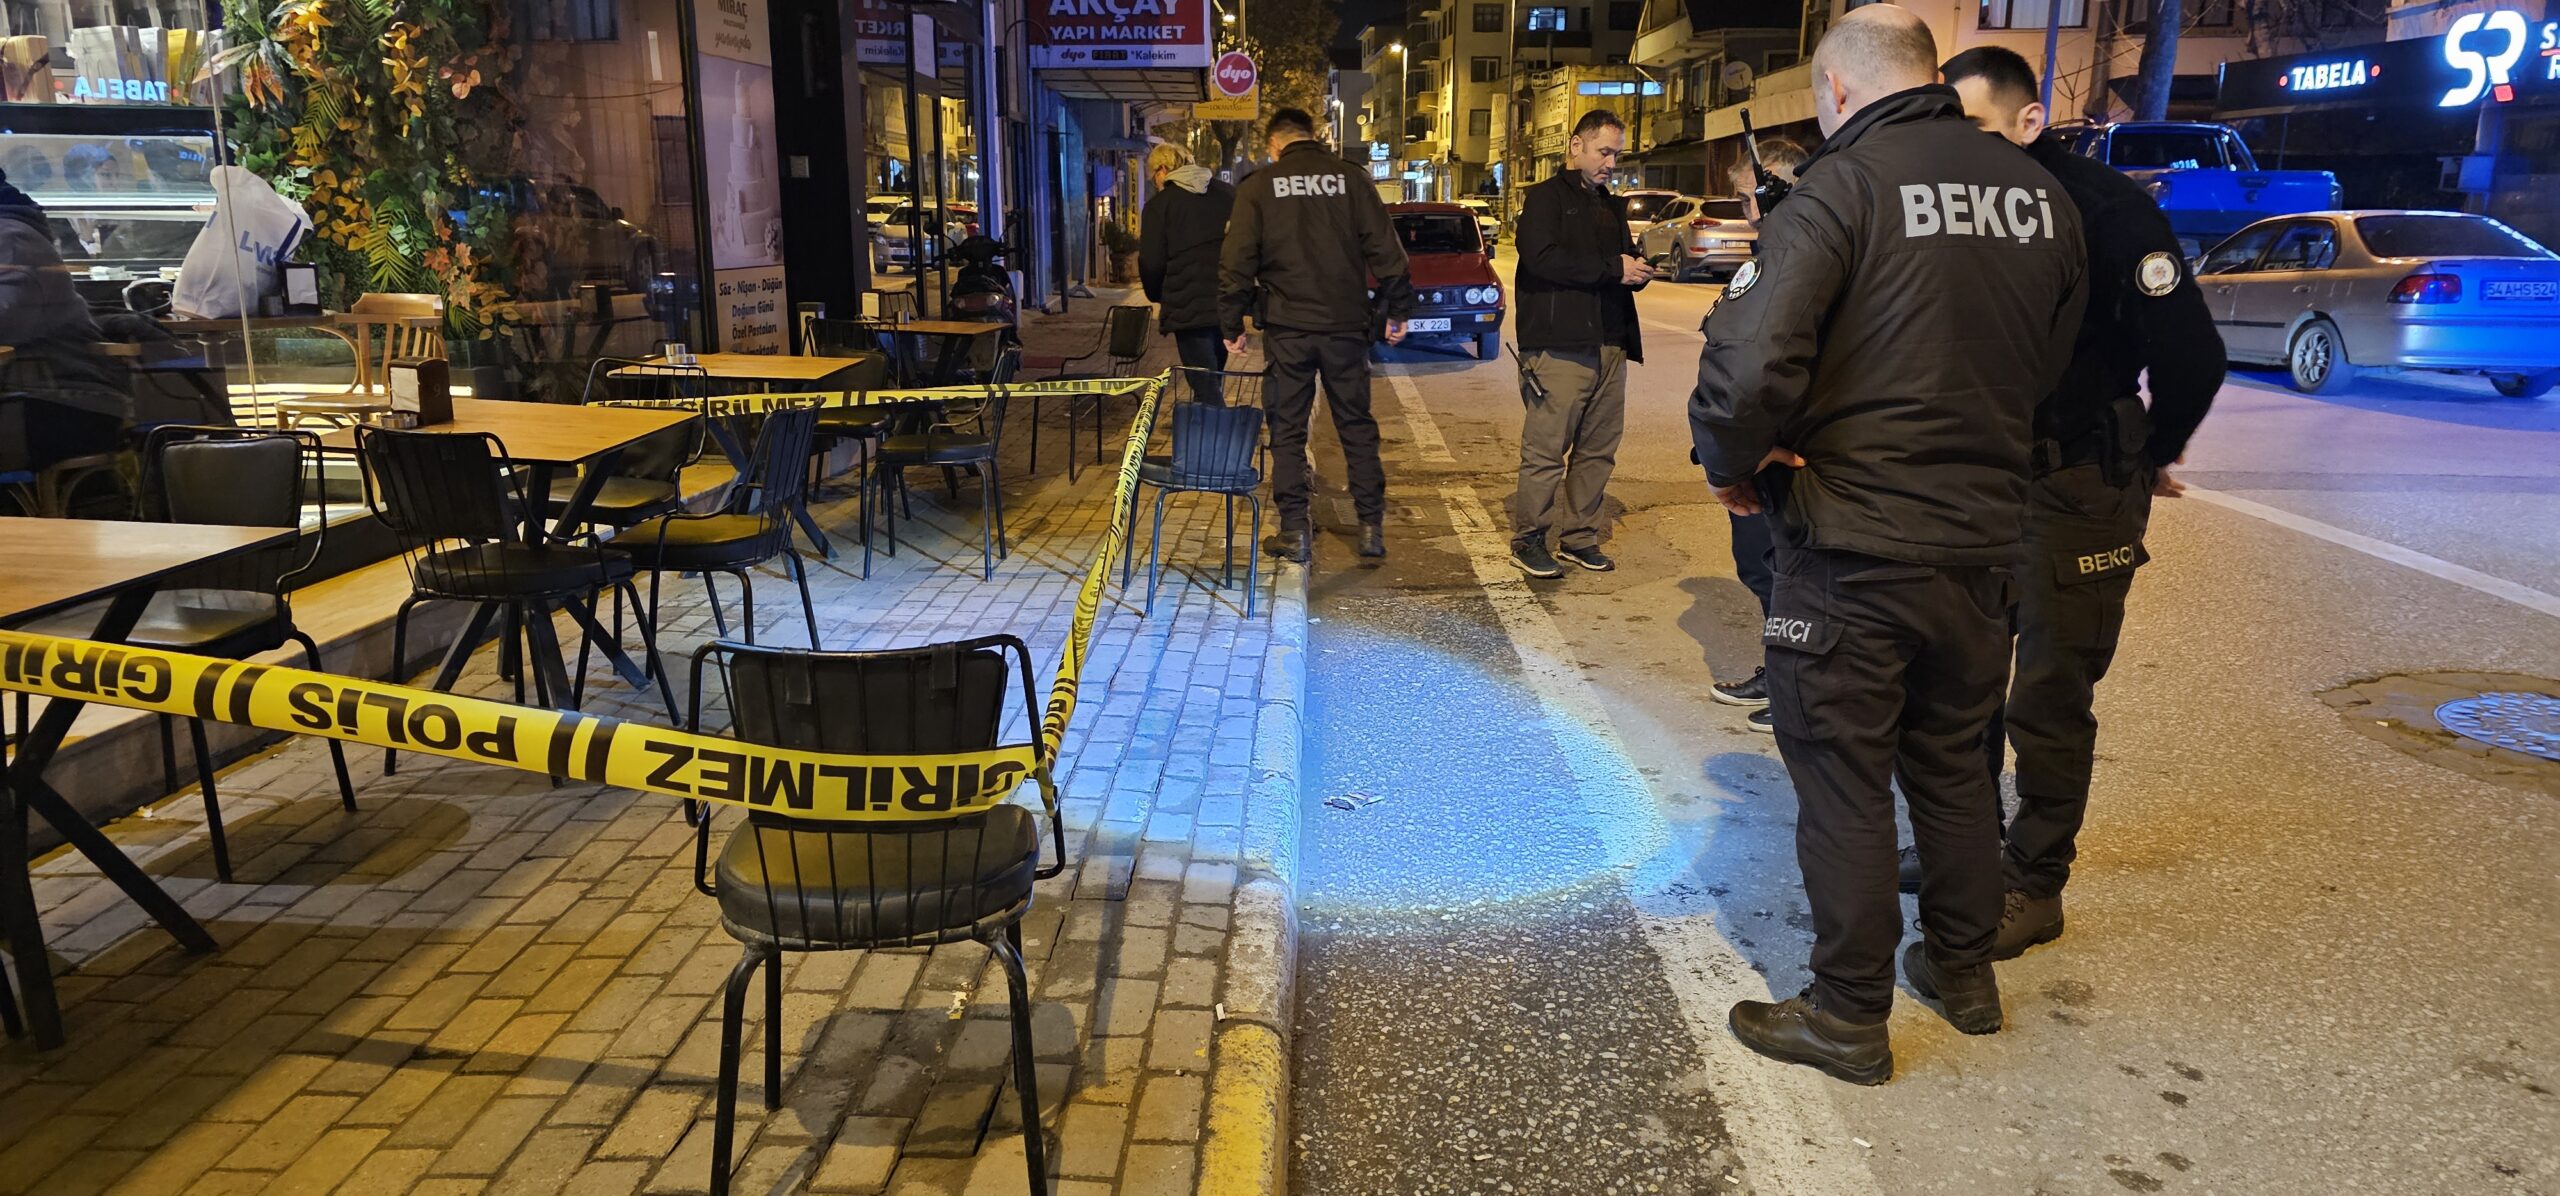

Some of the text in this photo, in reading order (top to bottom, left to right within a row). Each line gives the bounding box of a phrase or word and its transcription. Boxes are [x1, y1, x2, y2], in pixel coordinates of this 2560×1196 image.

[1051, 25, 1186, 40] YAPI MARKET
[1060, 48, 1086, 62] dyo
[1136, 50, 1176, 61] Kalekim
[1219, 64, 1251, 83] dyo
[2291, 60, 2367, 91] TABELA
[1413, 320, 1449, 330] SK 229
